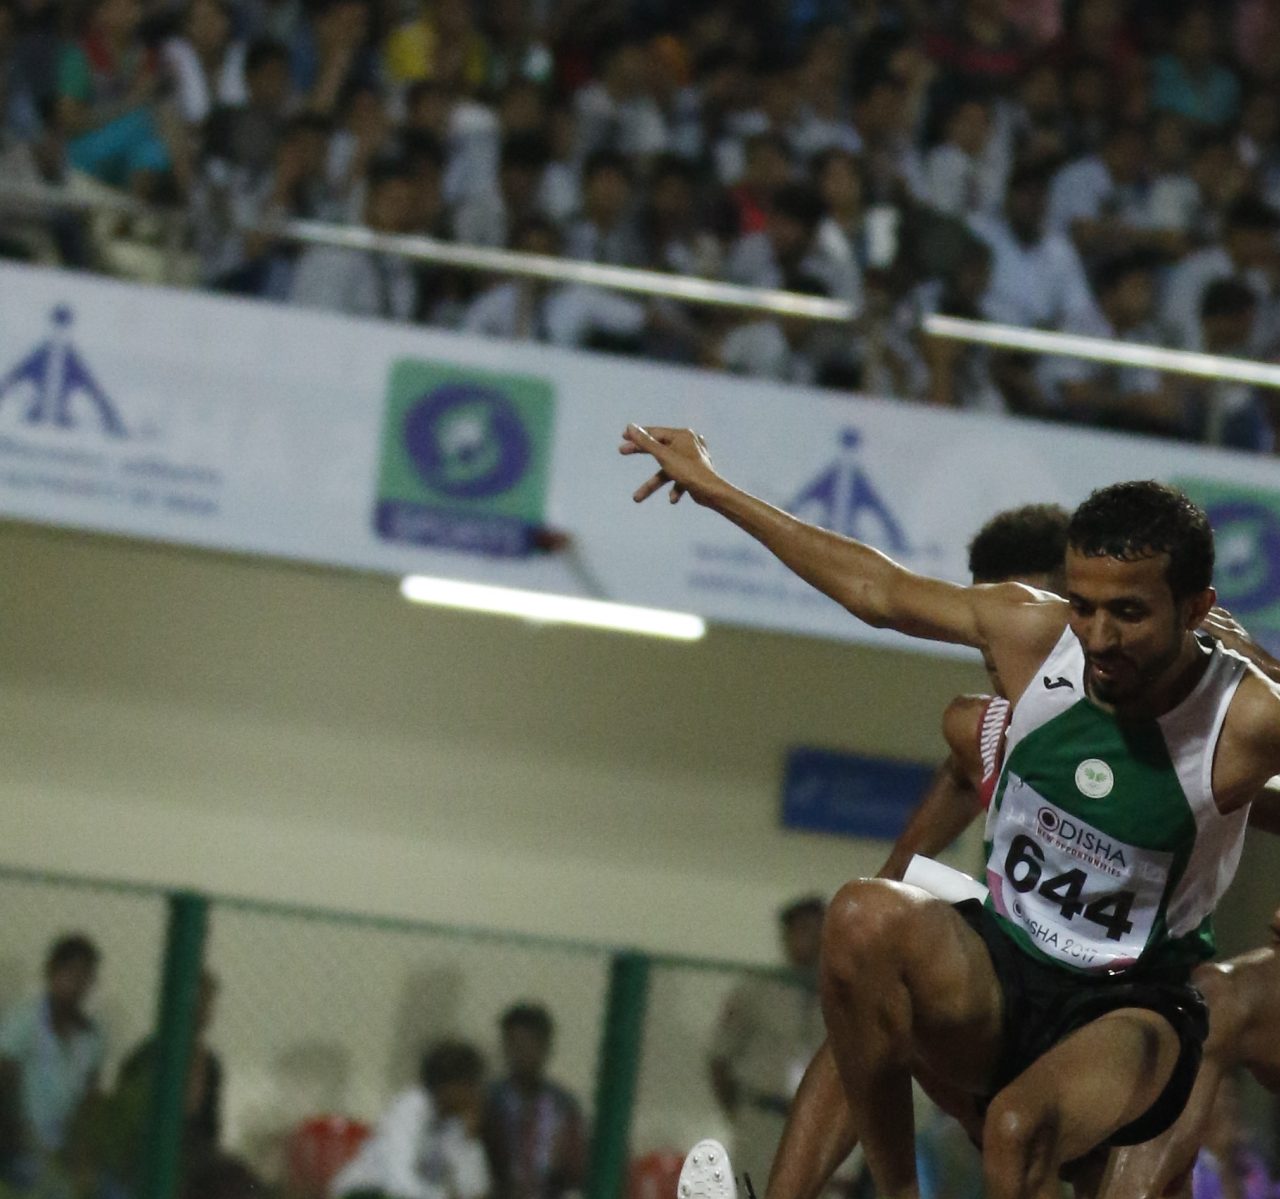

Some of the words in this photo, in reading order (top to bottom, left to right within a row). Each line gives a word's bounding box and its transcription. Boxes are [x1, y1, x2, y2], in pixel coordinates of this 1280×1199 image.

[1038, 807, 1126, 867] ODISHA
[1055, 839, 1121, 877] OPPORTUNITIES
[1005, 834, 1135, 942] 644
